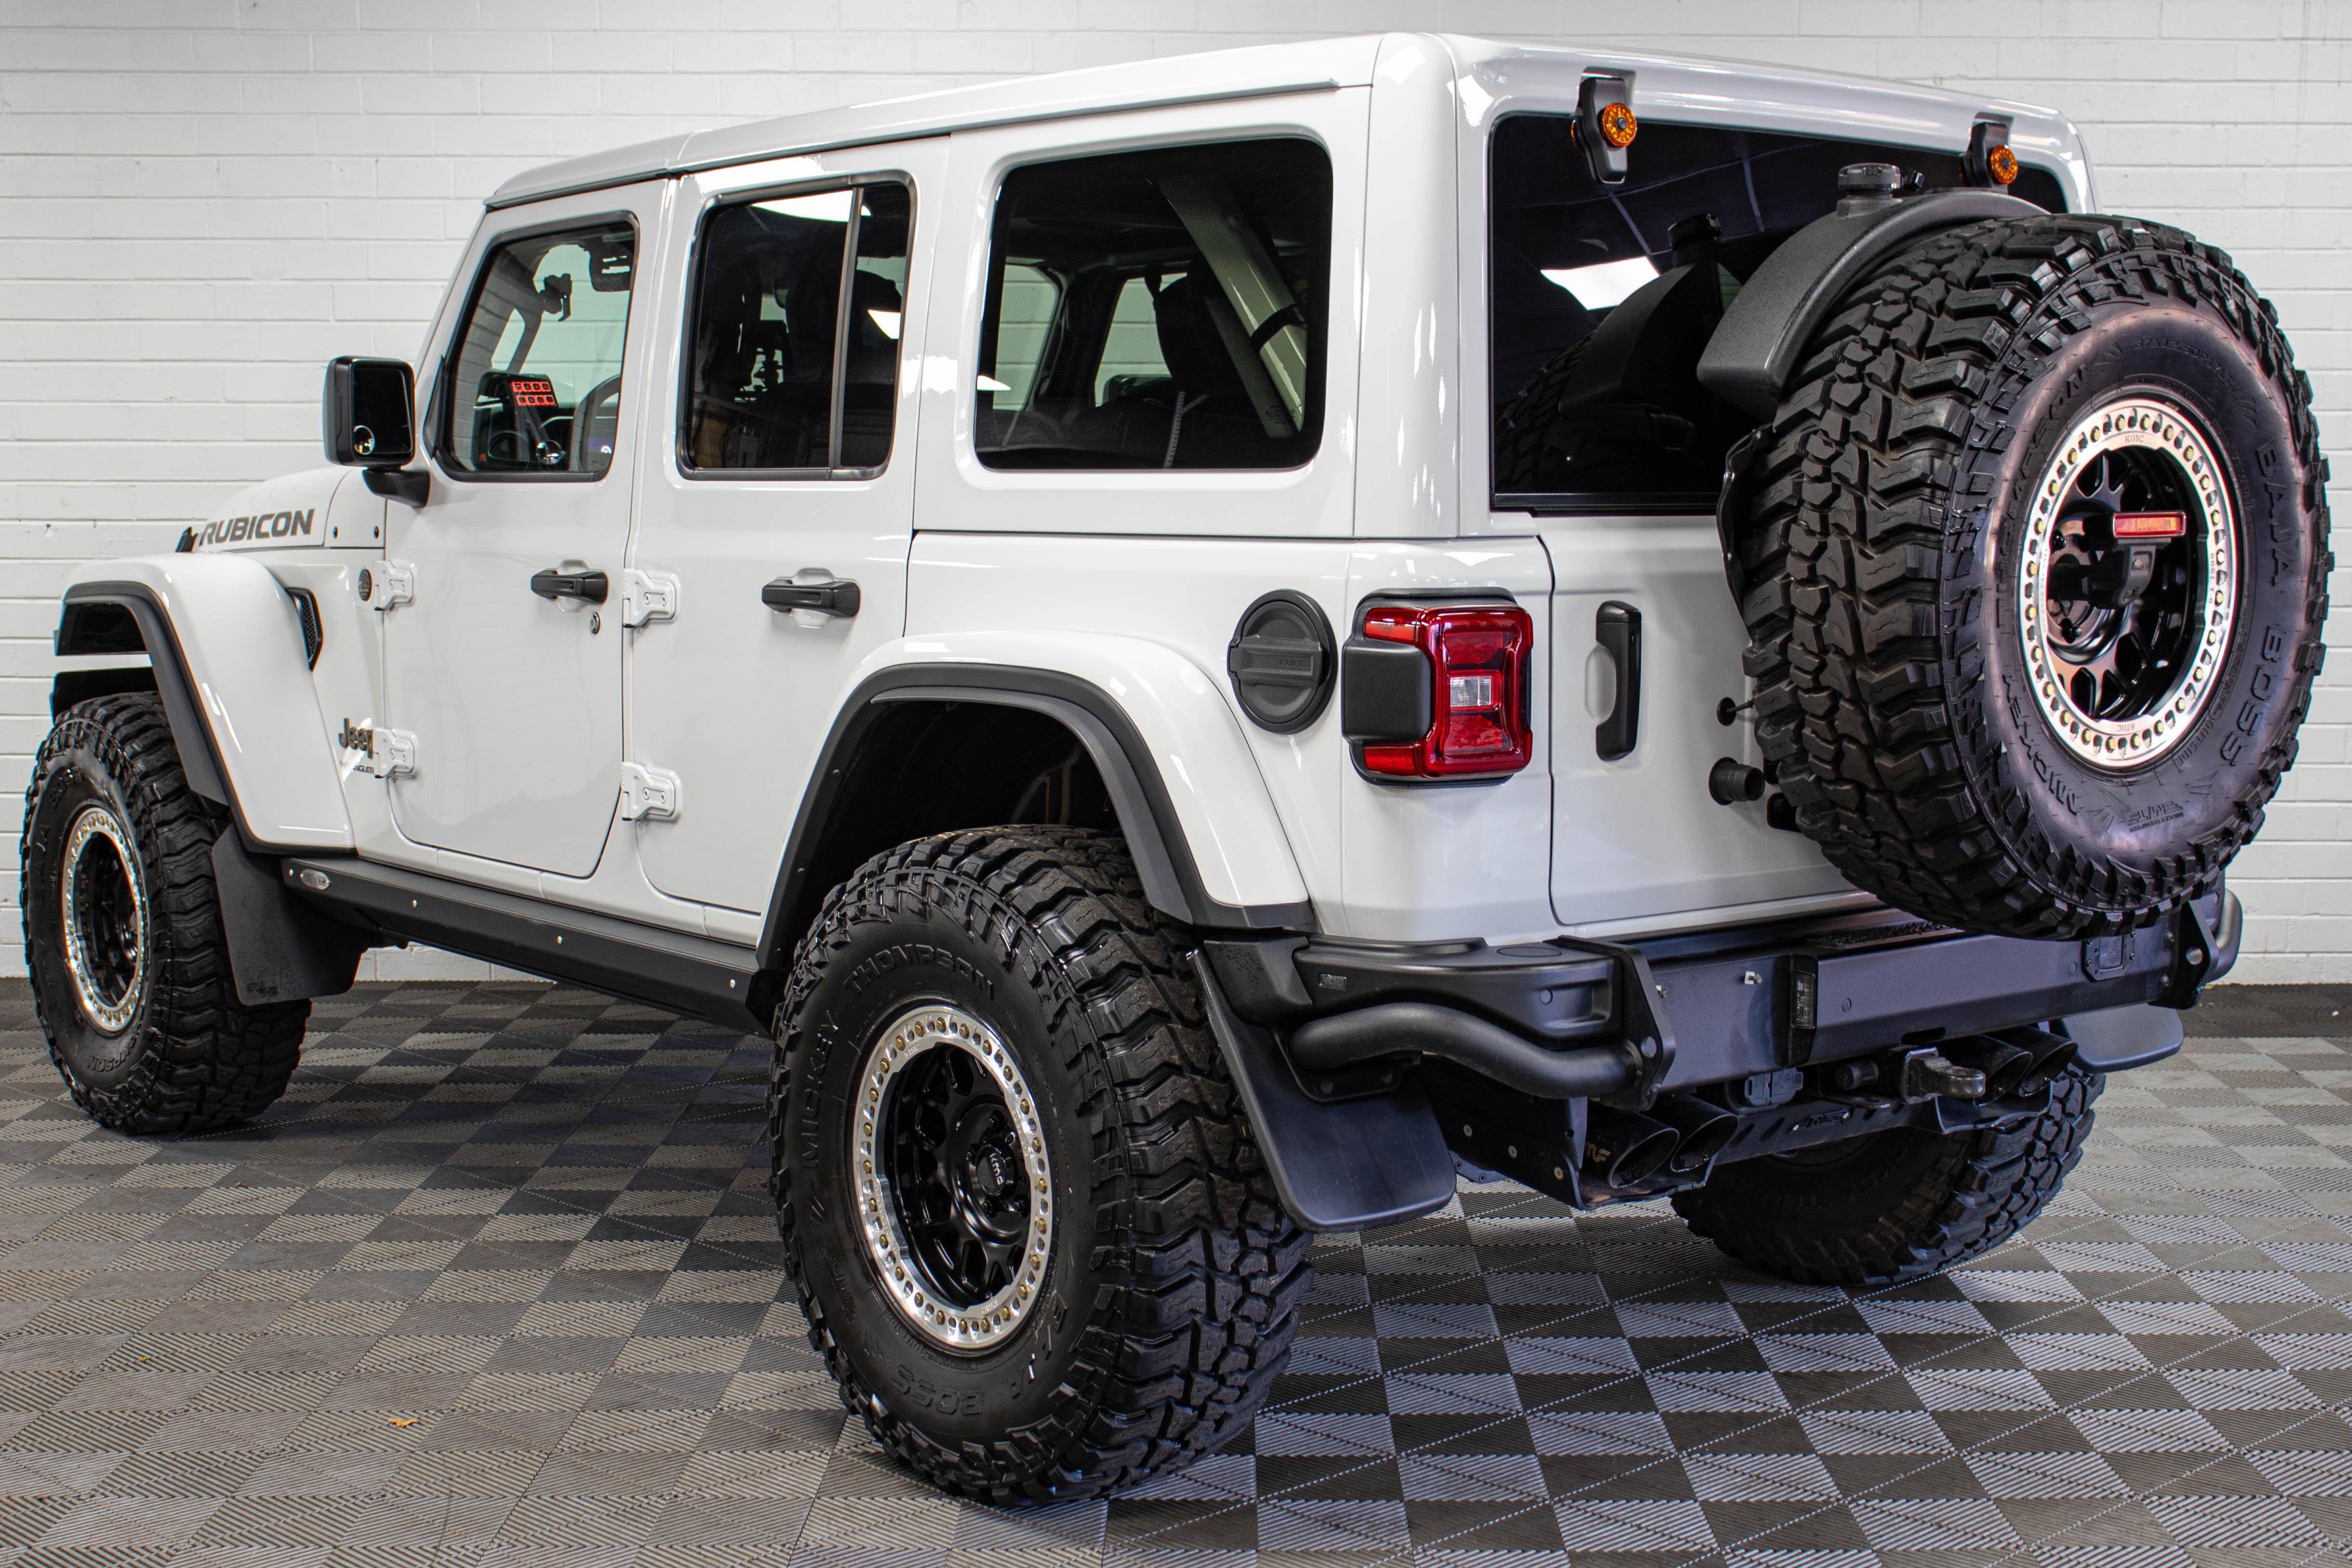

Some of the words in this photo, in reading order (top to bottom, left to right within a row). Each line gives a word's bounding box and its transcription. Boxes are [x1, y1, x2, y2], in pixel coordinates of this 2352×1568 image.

[199, 508, 316, 546] RUBICON
[2255, 440, 2295, 588] BAJA
[1279, 658, 1306, 668] FUEL
[2219, 625, 2284, 767] BOSS
[2002, 673, 2078, 816] MICKEY
[842, 942, 995, 1000] THOMPSON
[891, 1363, 984, 1417] BOSS
